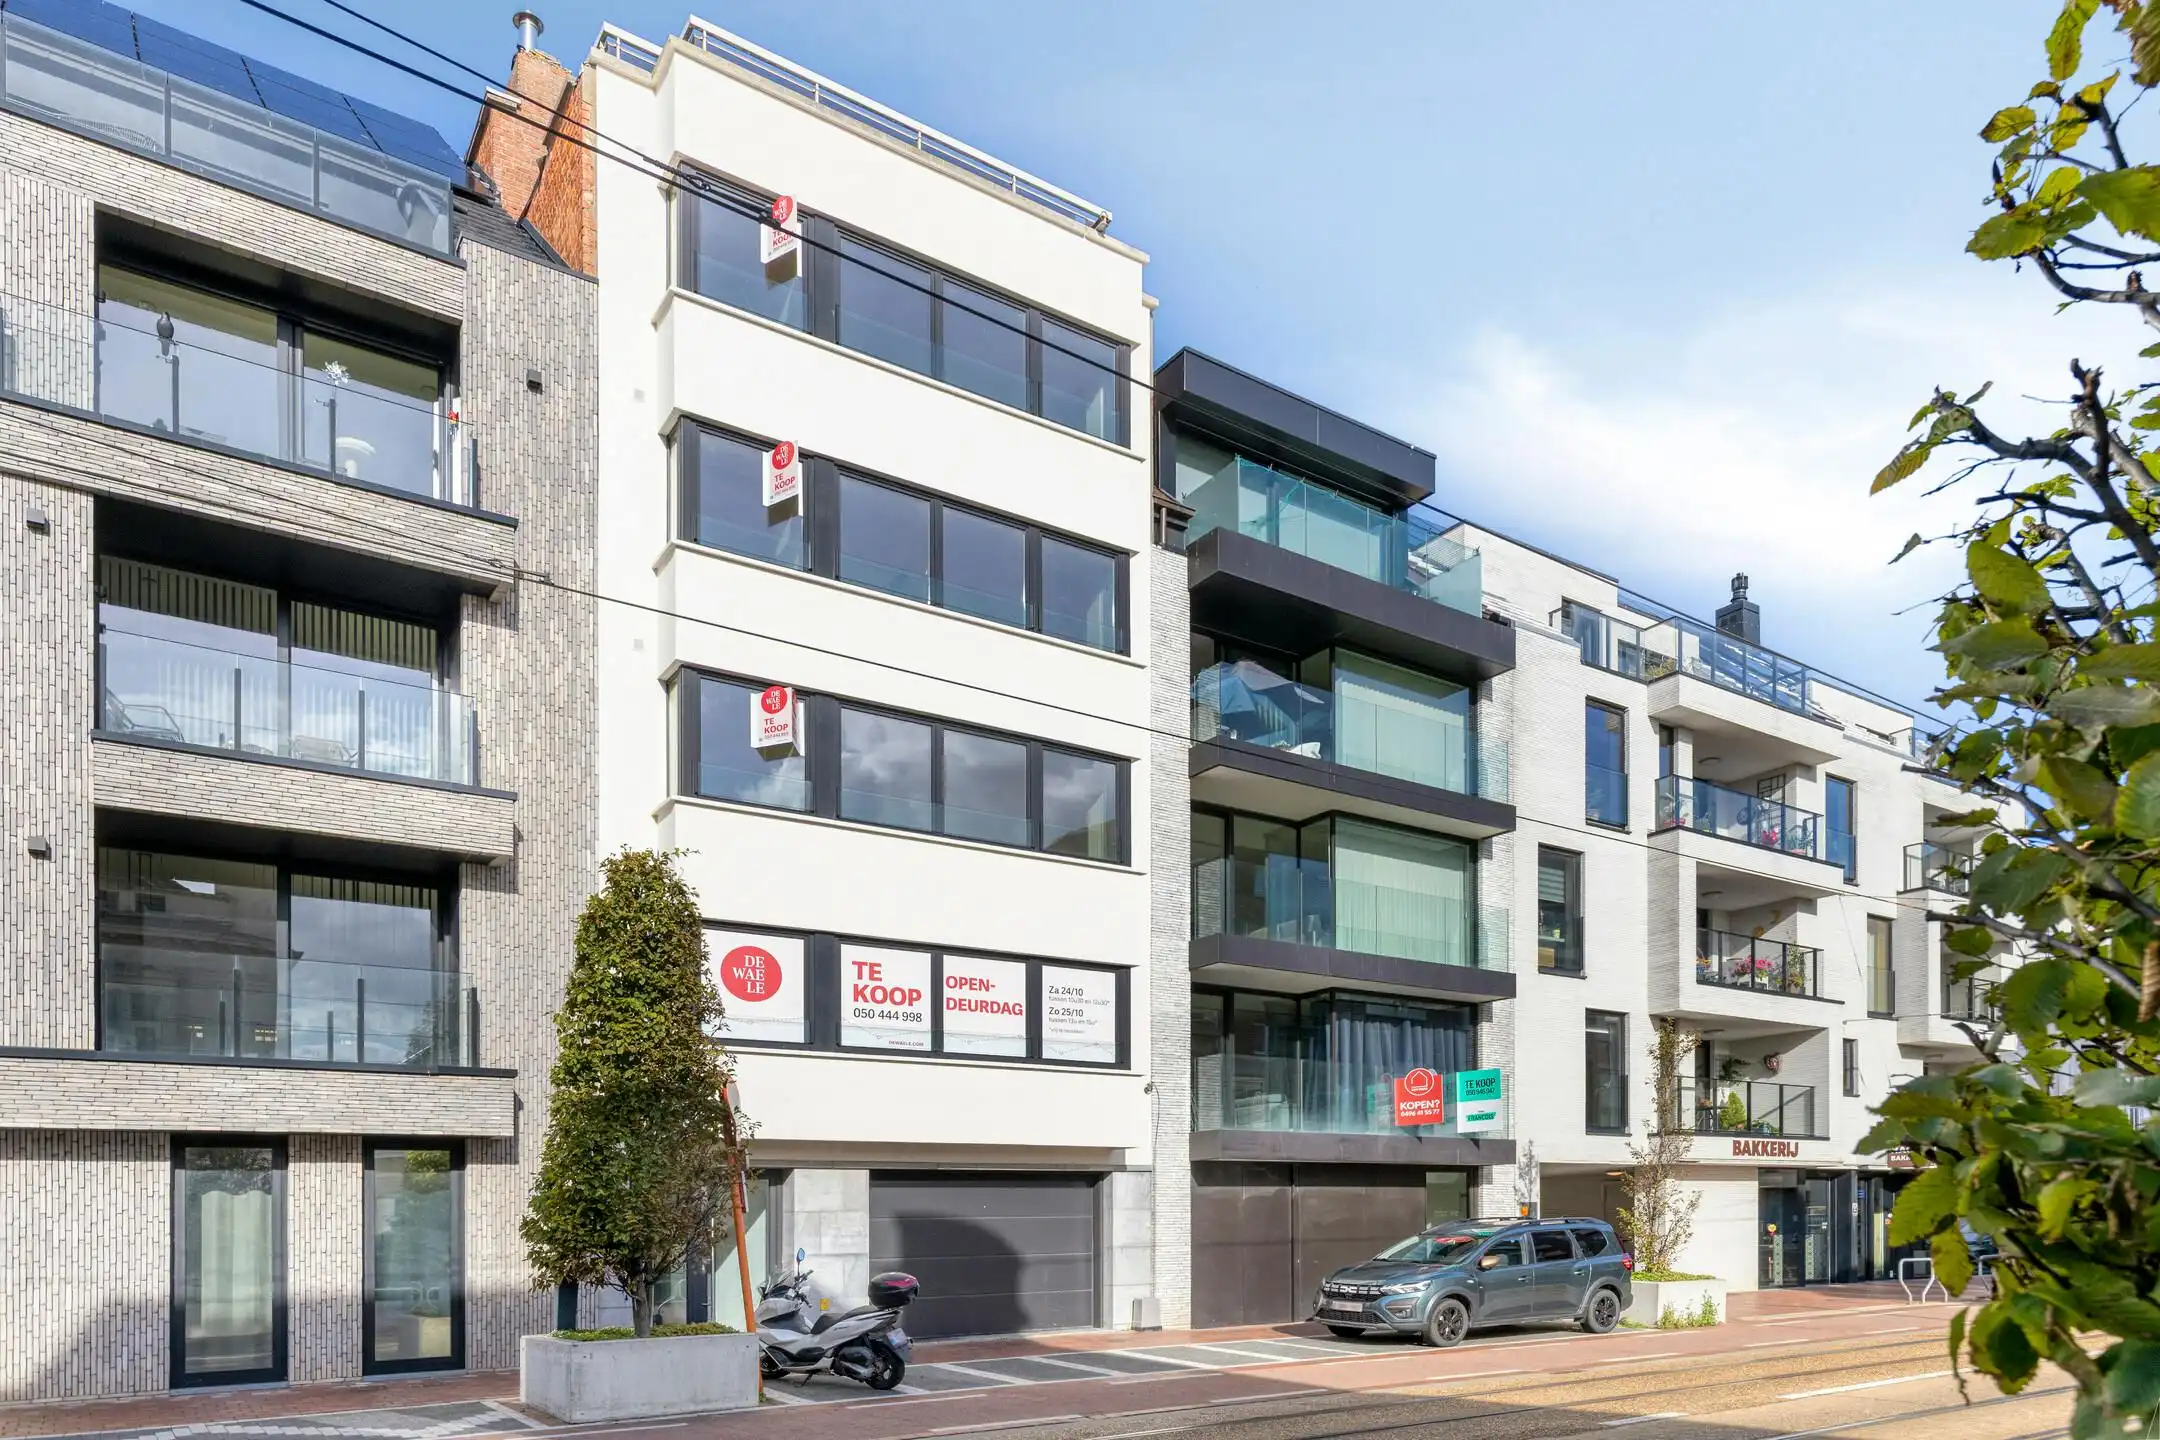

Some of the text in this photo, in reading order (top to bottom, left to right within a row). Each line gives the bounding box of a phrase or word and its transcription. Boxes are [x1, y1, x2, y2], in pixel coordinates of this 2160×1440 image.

[774, 473, 783, 482] TE
[774, 476, 796, 491] KOOP
[764, 717, 775, 726] TE
[764, 723, 789, 734] KOOP
[744, 954, 765, 968] DE
[732, 966, 765, 981] WAE
[852, 960, 882, 982] TE
[746, 981, 765, 994] LE
[945, 975, 996, 993] OPEN-
[1049, 985, 1084, 997] Za 24/10
[853, 983, 922, 1007] KOOP
[945, 997, 1024, 1016] DEURDAG
[1049, 1006, 1084, 1017] Zo 25/10
[853, 1007, 922, 1022] 050 444 998
[1465, 1078, 1496, 1088] TE KOOP
[1400, 1100, 1440, 1110] KOPEN?
[1733, 1140, 1799, 1157] BAKKERIJ
